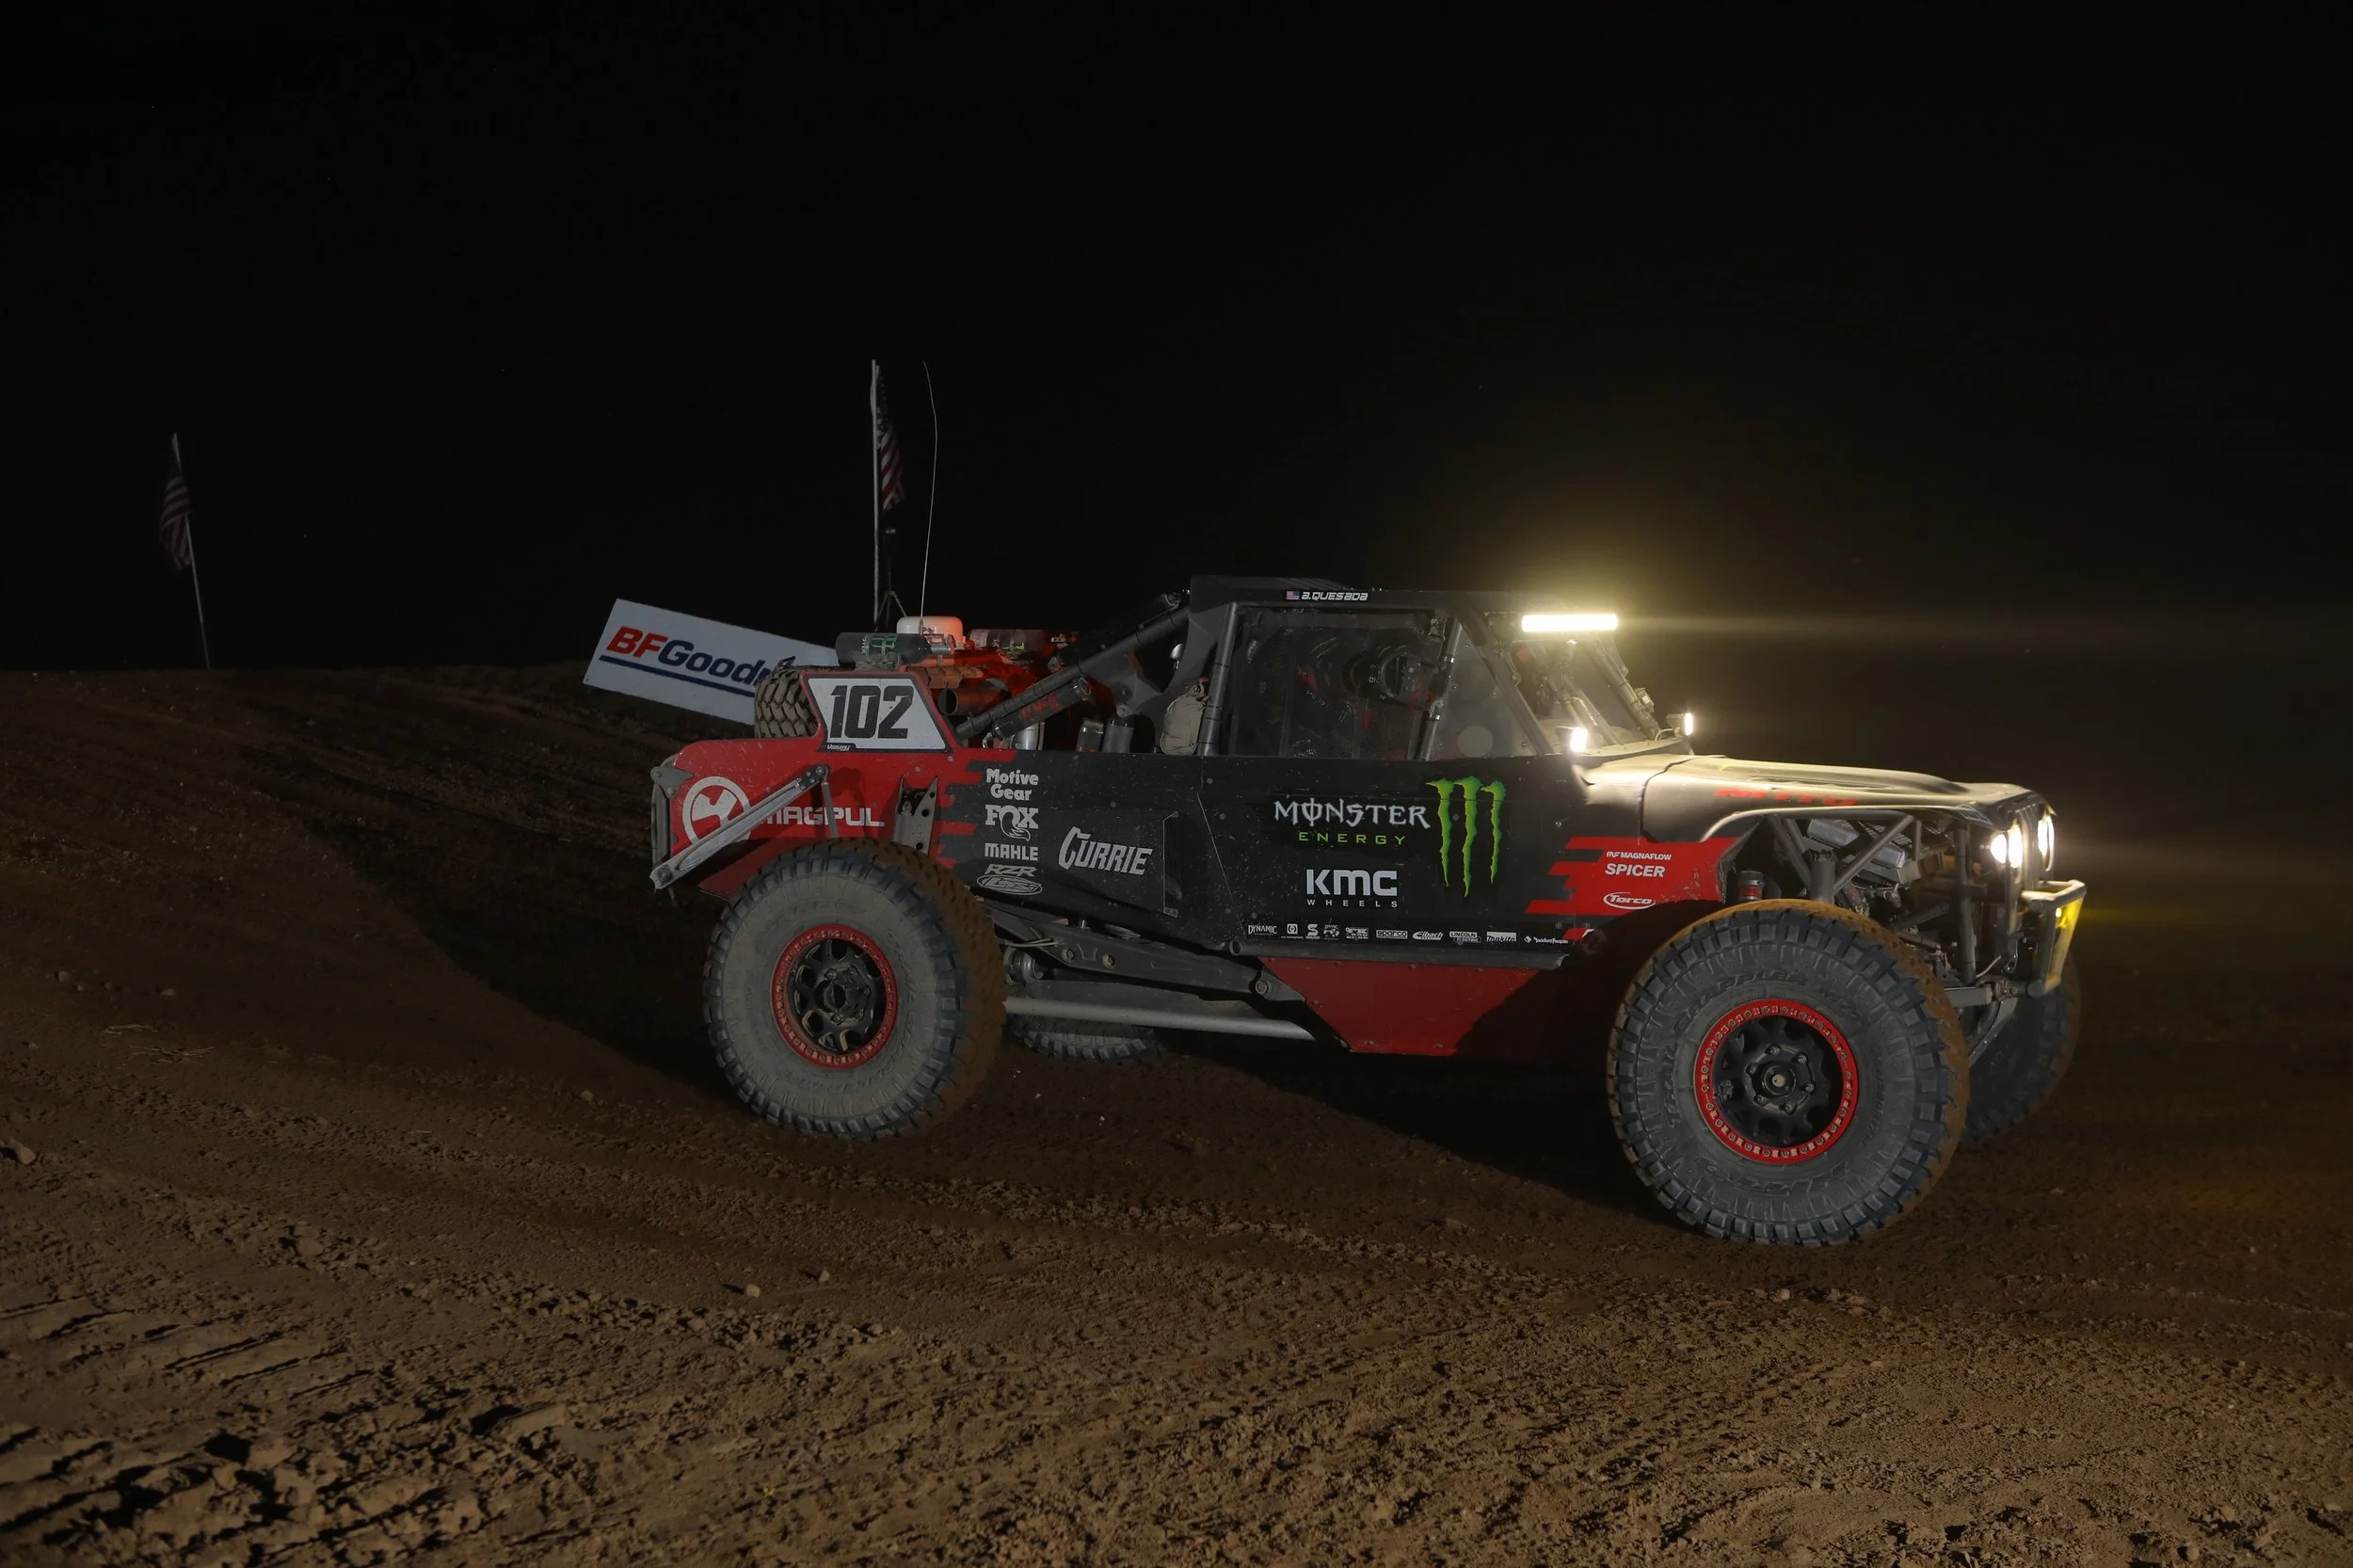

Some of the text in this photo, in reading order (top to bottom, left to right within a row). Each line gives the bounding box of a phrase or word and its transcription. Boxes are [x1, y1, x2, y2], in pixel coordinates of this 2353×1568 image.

[829, 685, 915, 740] 102
[985, 768, 1039, 786] Motive
[990, 783, 1032, 801] Gear
[984, 805, 1039, 835] FOX
[1273, 798, 1431, 829] MONSTER
[1298, 830, 1406, 846] ENERGY
[984, 842, 1039, 861] MAHLE
[1058, 826, 1153, 875] CURRIE
[1620, 852, 1672, 860] MAGNAFLOW
[1605, 863, 1666, 878] SPICER
[1305, 869, 1398, 897] KMC
[1306, 899, 1398, 908] WHEELS
[1609, 894, 1653, 905] Torco
[1247, 923, 1277, 935] DYNAMIC
[1376, 929, 1408, 938] sparco
[1412, 930, 1445, 941] Eibach
